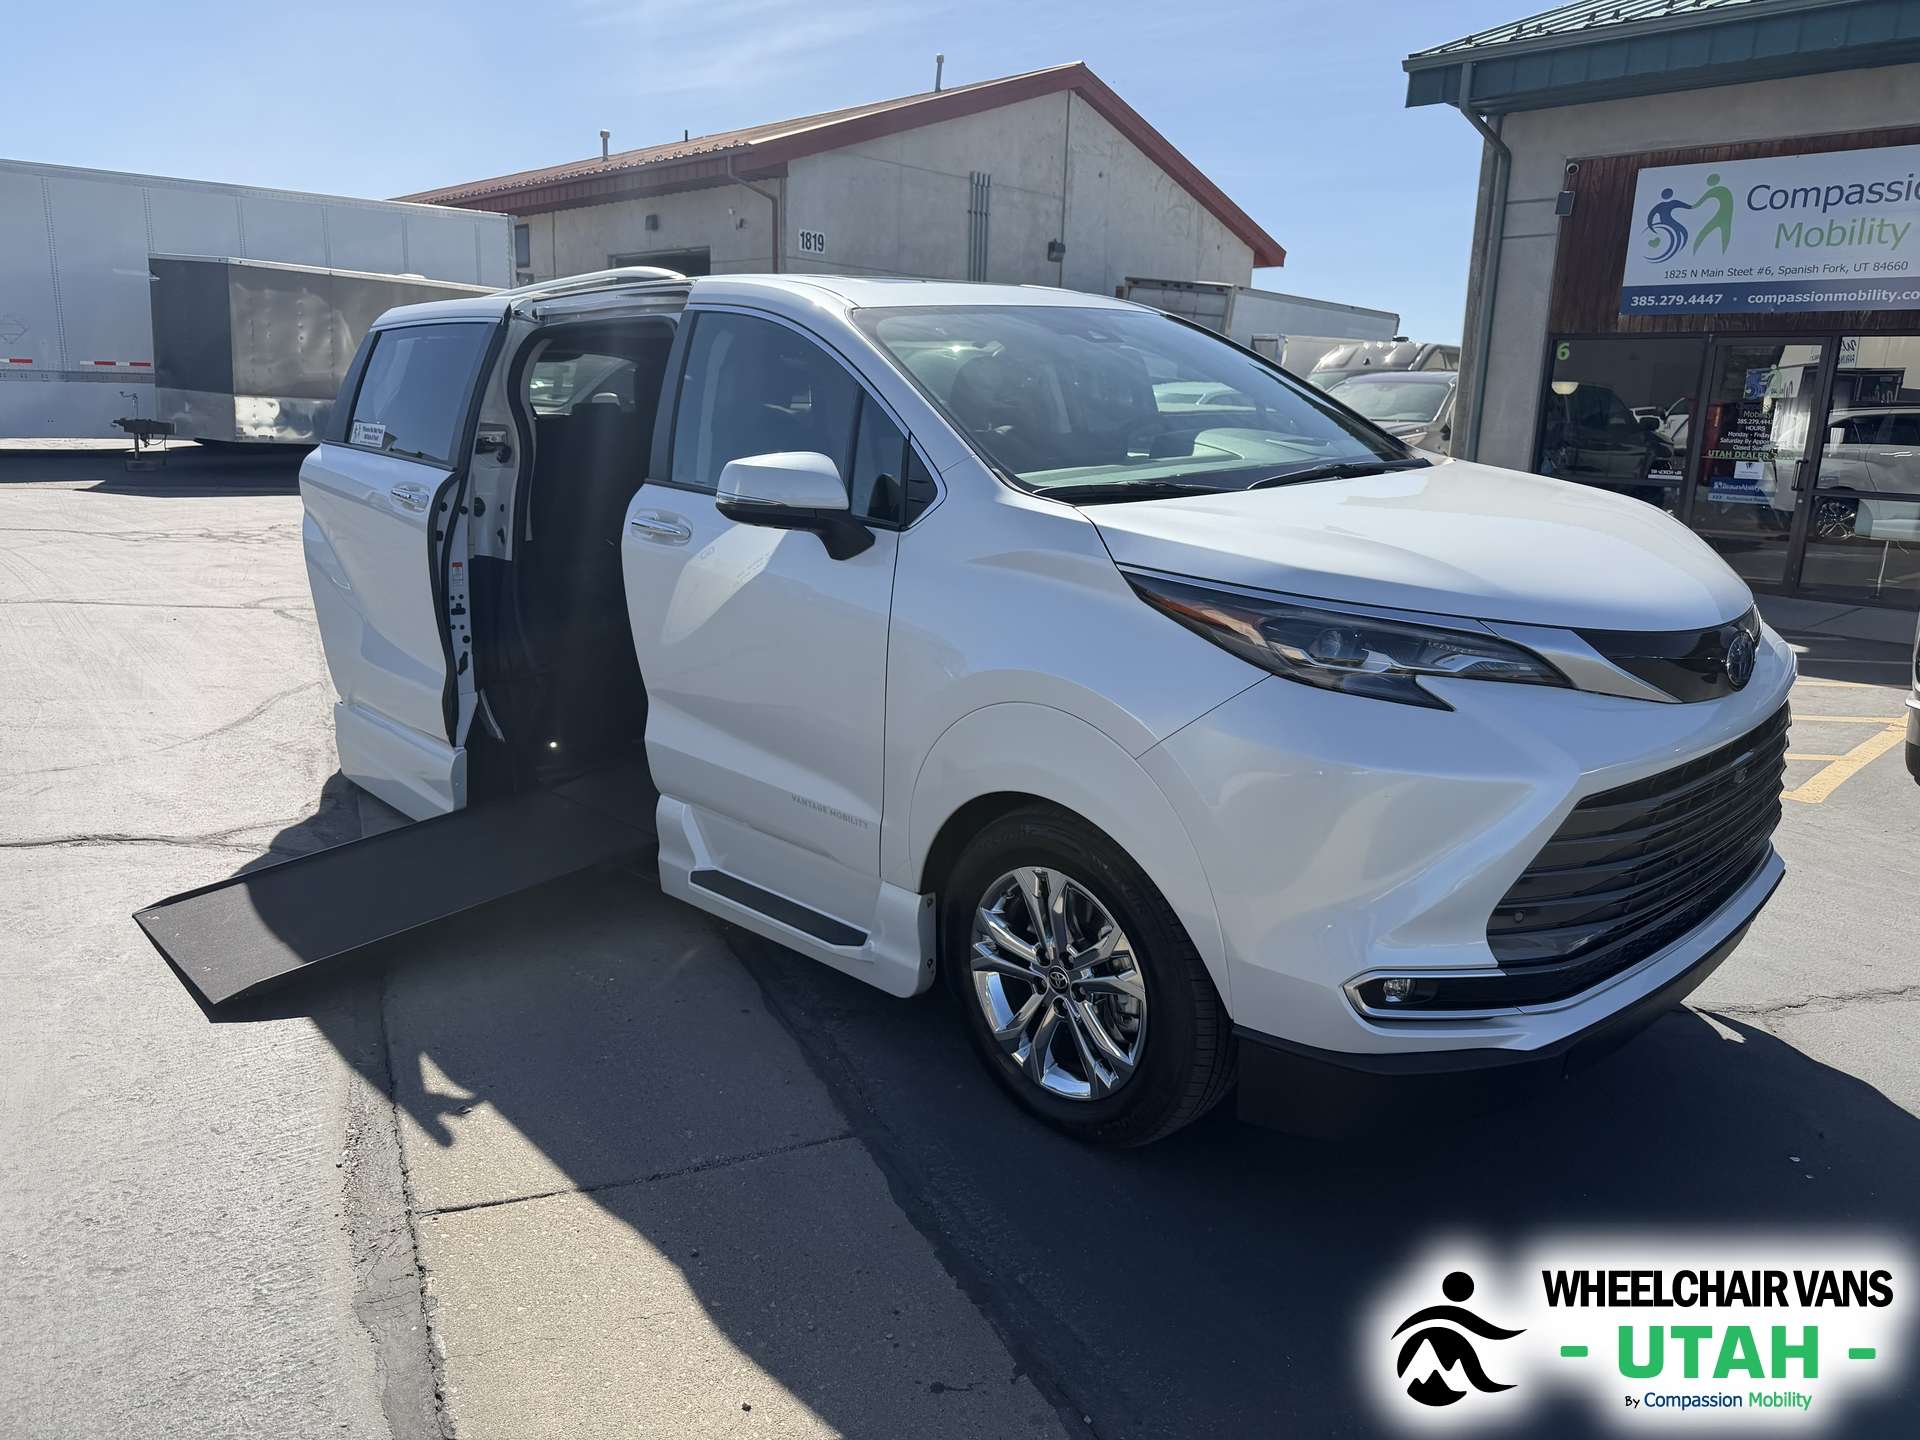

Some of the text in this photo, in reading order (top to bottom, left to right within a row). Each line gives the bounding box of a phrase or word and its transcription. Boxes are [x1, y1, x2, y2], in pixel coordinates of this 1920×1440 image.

[800, 231, 824, 252] 1819
[1774, 216, 1912, 250] Mobility
[1664, 260, 1909, 279] 1825 N Main Steet #6, Spanish Fork, UT 84660
[1630, 293, 1724, 307] 385.279.4447
[1556, 342, 1570, 361] 6
[1708, 449, 1733, 459] UTAH
[1734, 450, 1769, 461] DEALER
